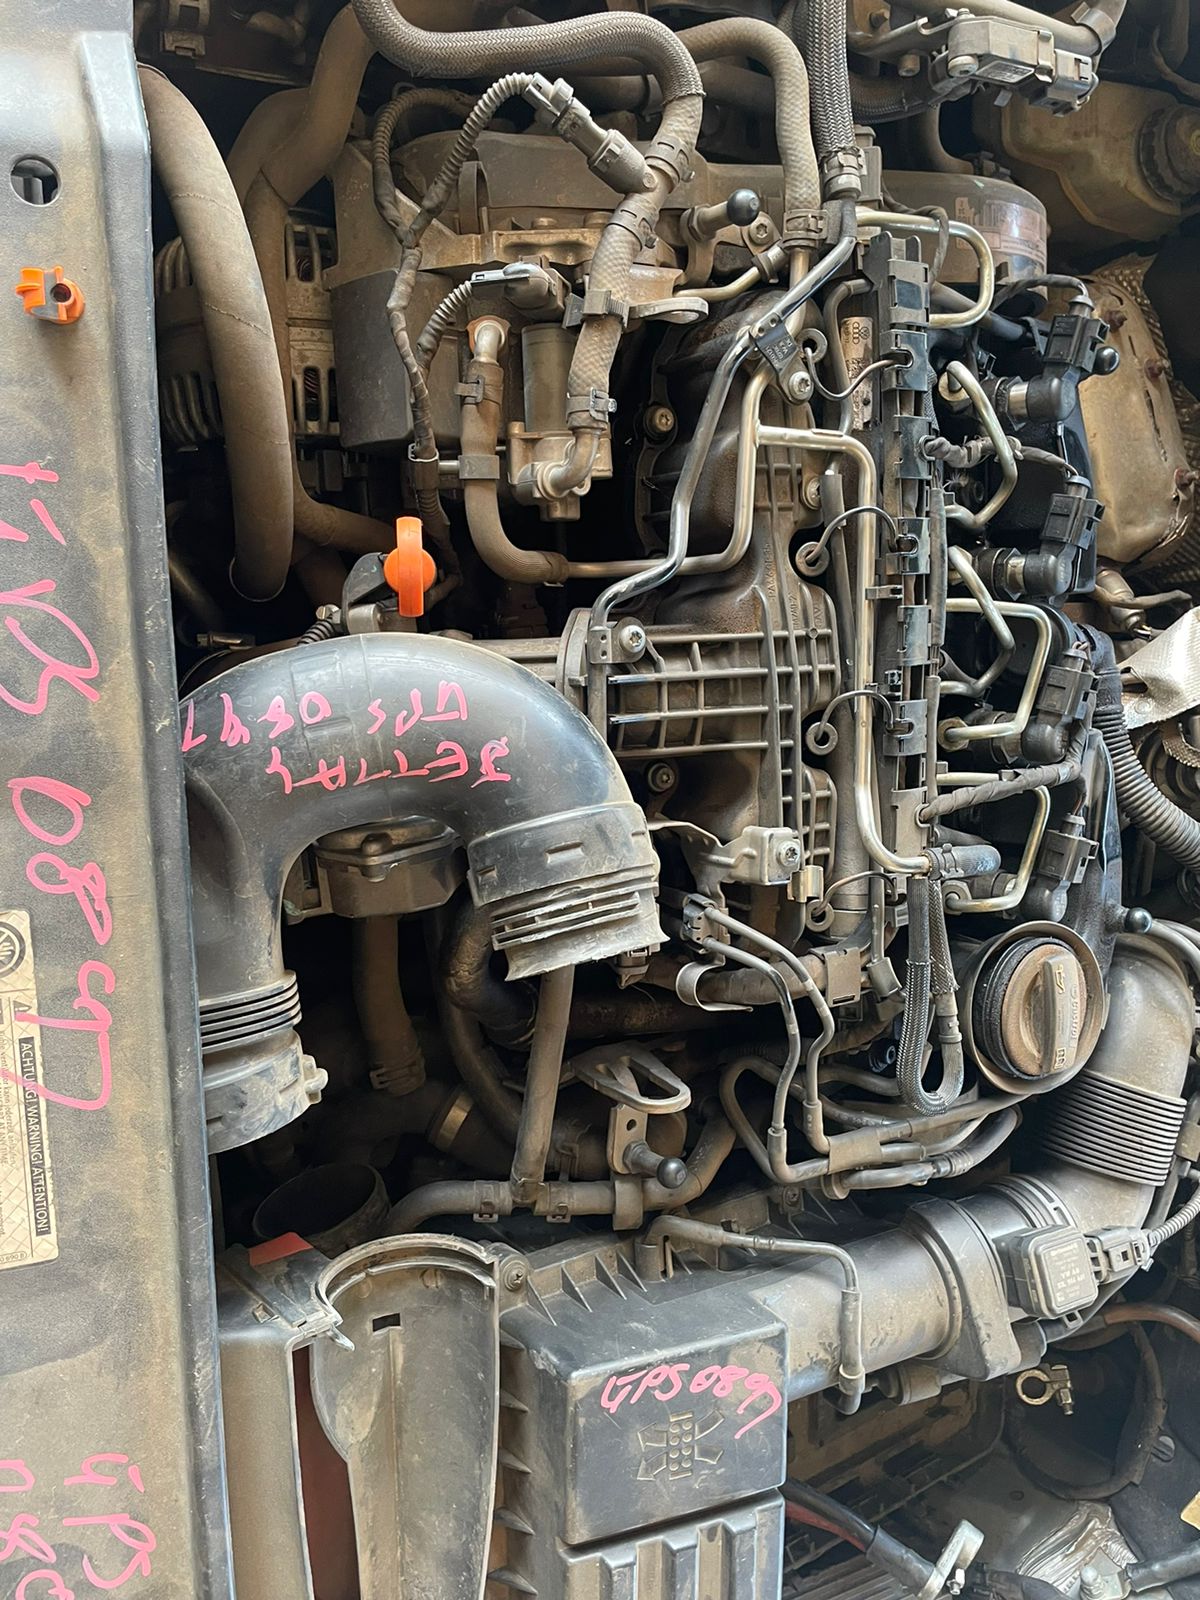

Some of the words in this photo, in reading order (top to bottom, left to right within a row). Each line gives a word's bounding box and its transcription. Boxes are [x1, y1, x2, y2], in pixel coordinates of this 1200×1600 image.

[21, 1042, 37, 1103] ACHTUNG!
[27, 1104, 43, 1165] WARNING!
[32, 1166, 48, 1233] ATTENTION!
